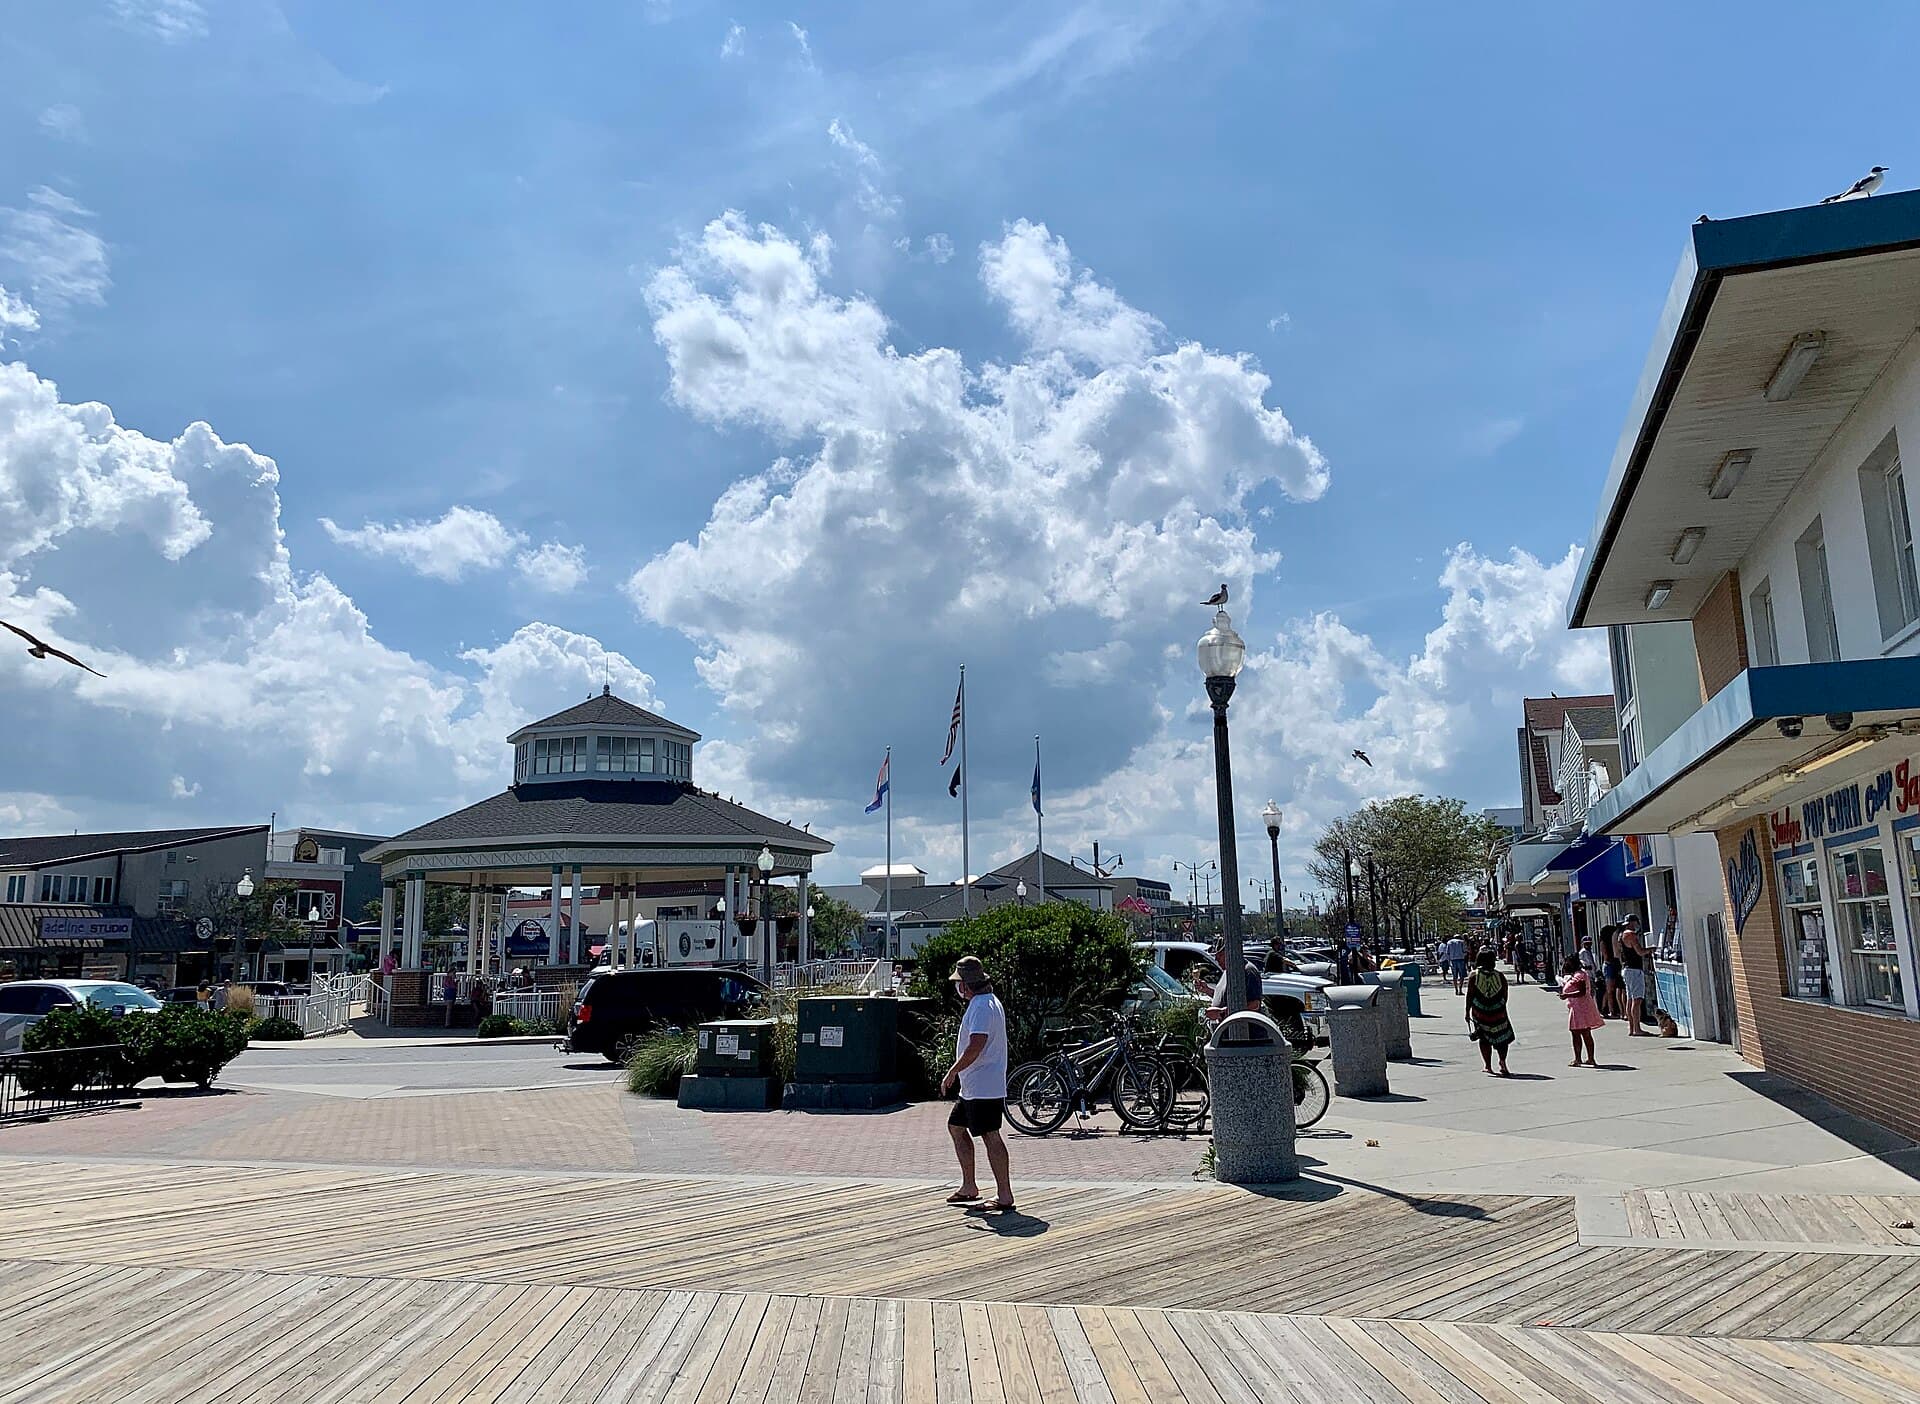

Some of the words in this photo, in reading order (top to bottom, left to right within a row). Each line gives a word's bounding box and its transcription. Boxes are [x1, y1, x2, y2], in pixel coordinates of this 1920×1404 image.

[1802, 797, 1825, 840] POP
[1825, 783, 1862, 833] CORN
[90, 924, 129, 933] STUDIO
